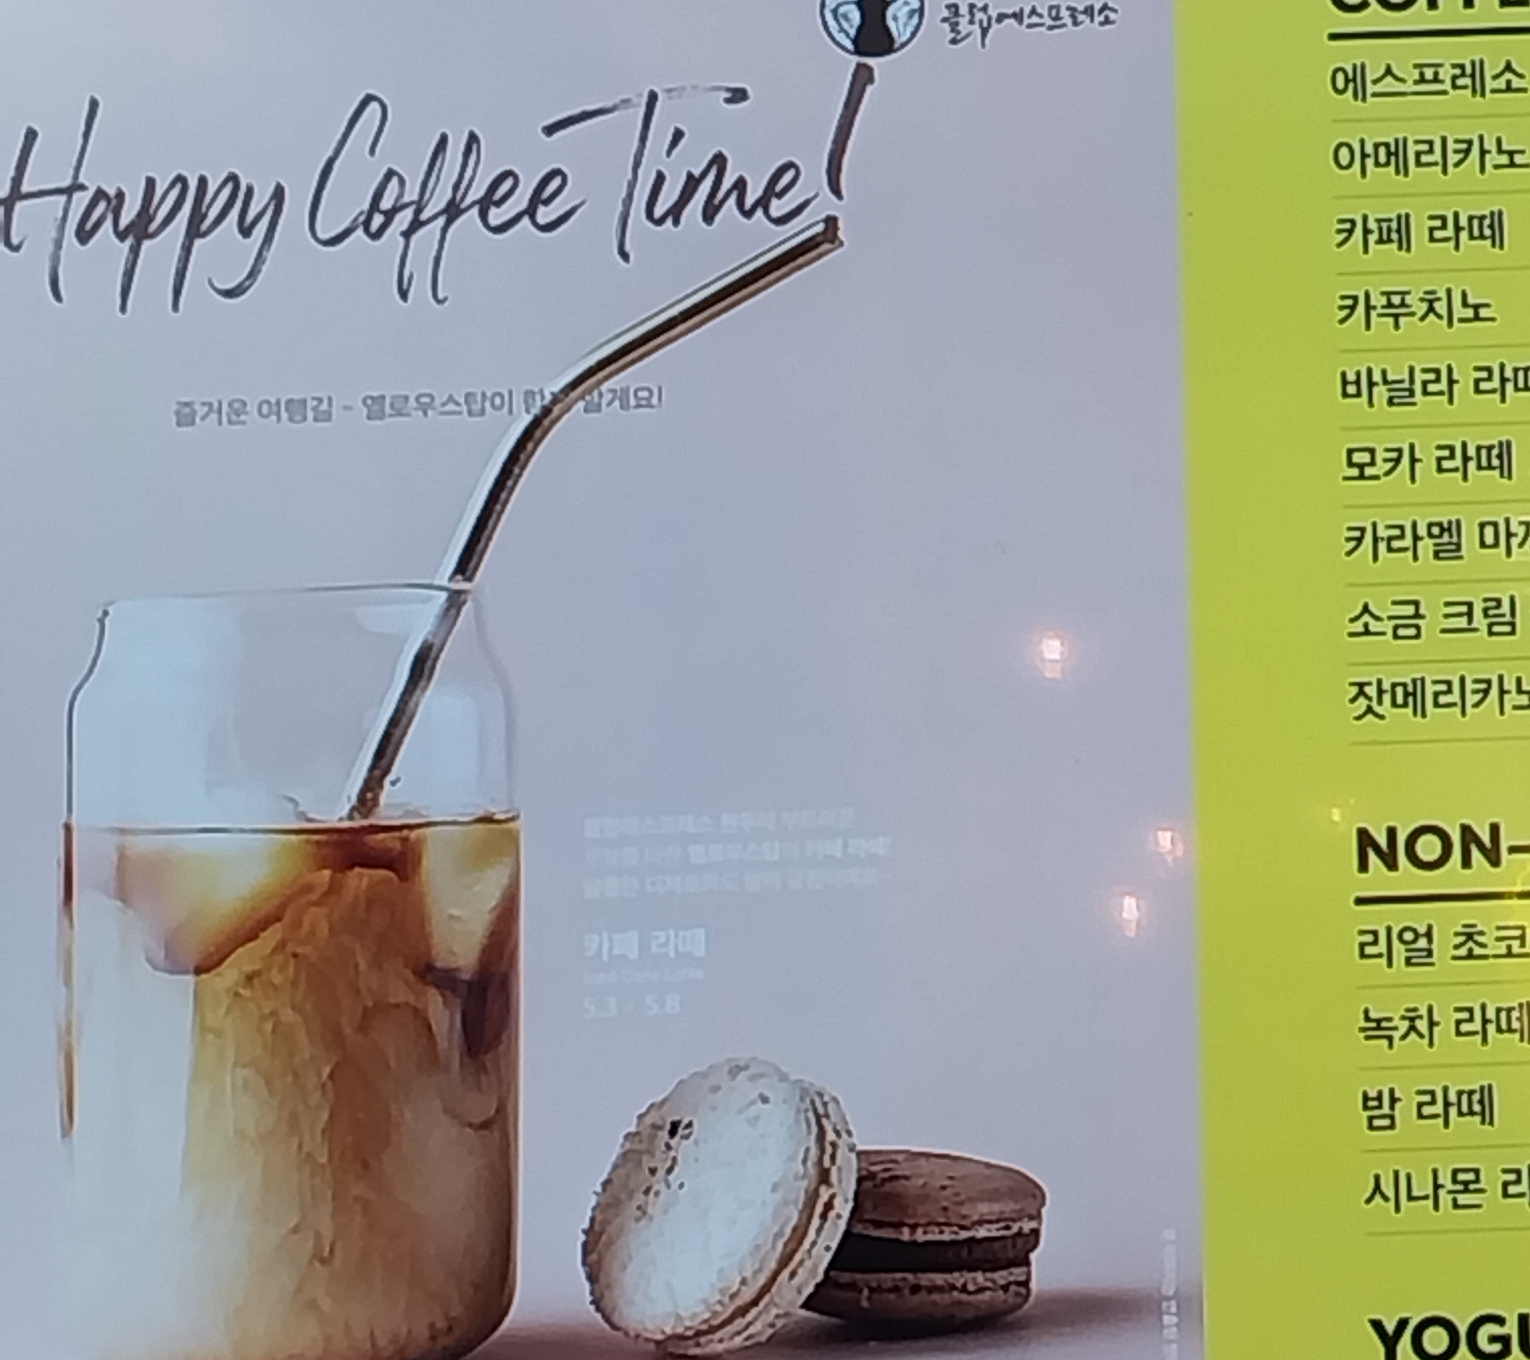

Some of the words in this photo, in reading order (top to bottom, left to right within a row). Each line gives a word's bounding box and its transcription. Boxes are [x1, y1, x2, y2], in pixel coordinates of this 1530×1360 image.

[941, 2, 1118, 49] 클럽에스프레소
[1331, 59, 1528, 103] 에스프레소
[1333, 134, 1530, 179] 아메리카노
[0, 95, 288, 315] Happy
[308, 92, 586, 304] Coffee
[541, 60, 876, 264] Time!
[1336, 213, 1411, 254] 카페
[1427, 209, 1504, 252] 라떼
[1338, 287, 1496, 331] 카푸치노
[174, 399, 248, 427] 즐거운
[258, 396, 332, 424] 여행길
[362, 389, 513, 420] 옐로우스탑이
[1341, 364, 1459, 408] 바닐라
[1343, 443, 1422, 484] 모카
[1435, 440, 1512, 482] 라떼
[1345, 519, 1463, 563] 카라멜
[1347, 600, 1426, 640] 소금
[1440, 595, 1516, 637] 크림
[1358, 924, 1435, 968] 리얼
[1451, 924, 1530, 960] 초코
[1359, 1004, 1440, 1050] 녹차
[1362, 1088, 1402, 1131] 밤
[1415, 1084, 1494, 1129] 라떼
[1365, 1168, 1487, 1214] 시나몬
